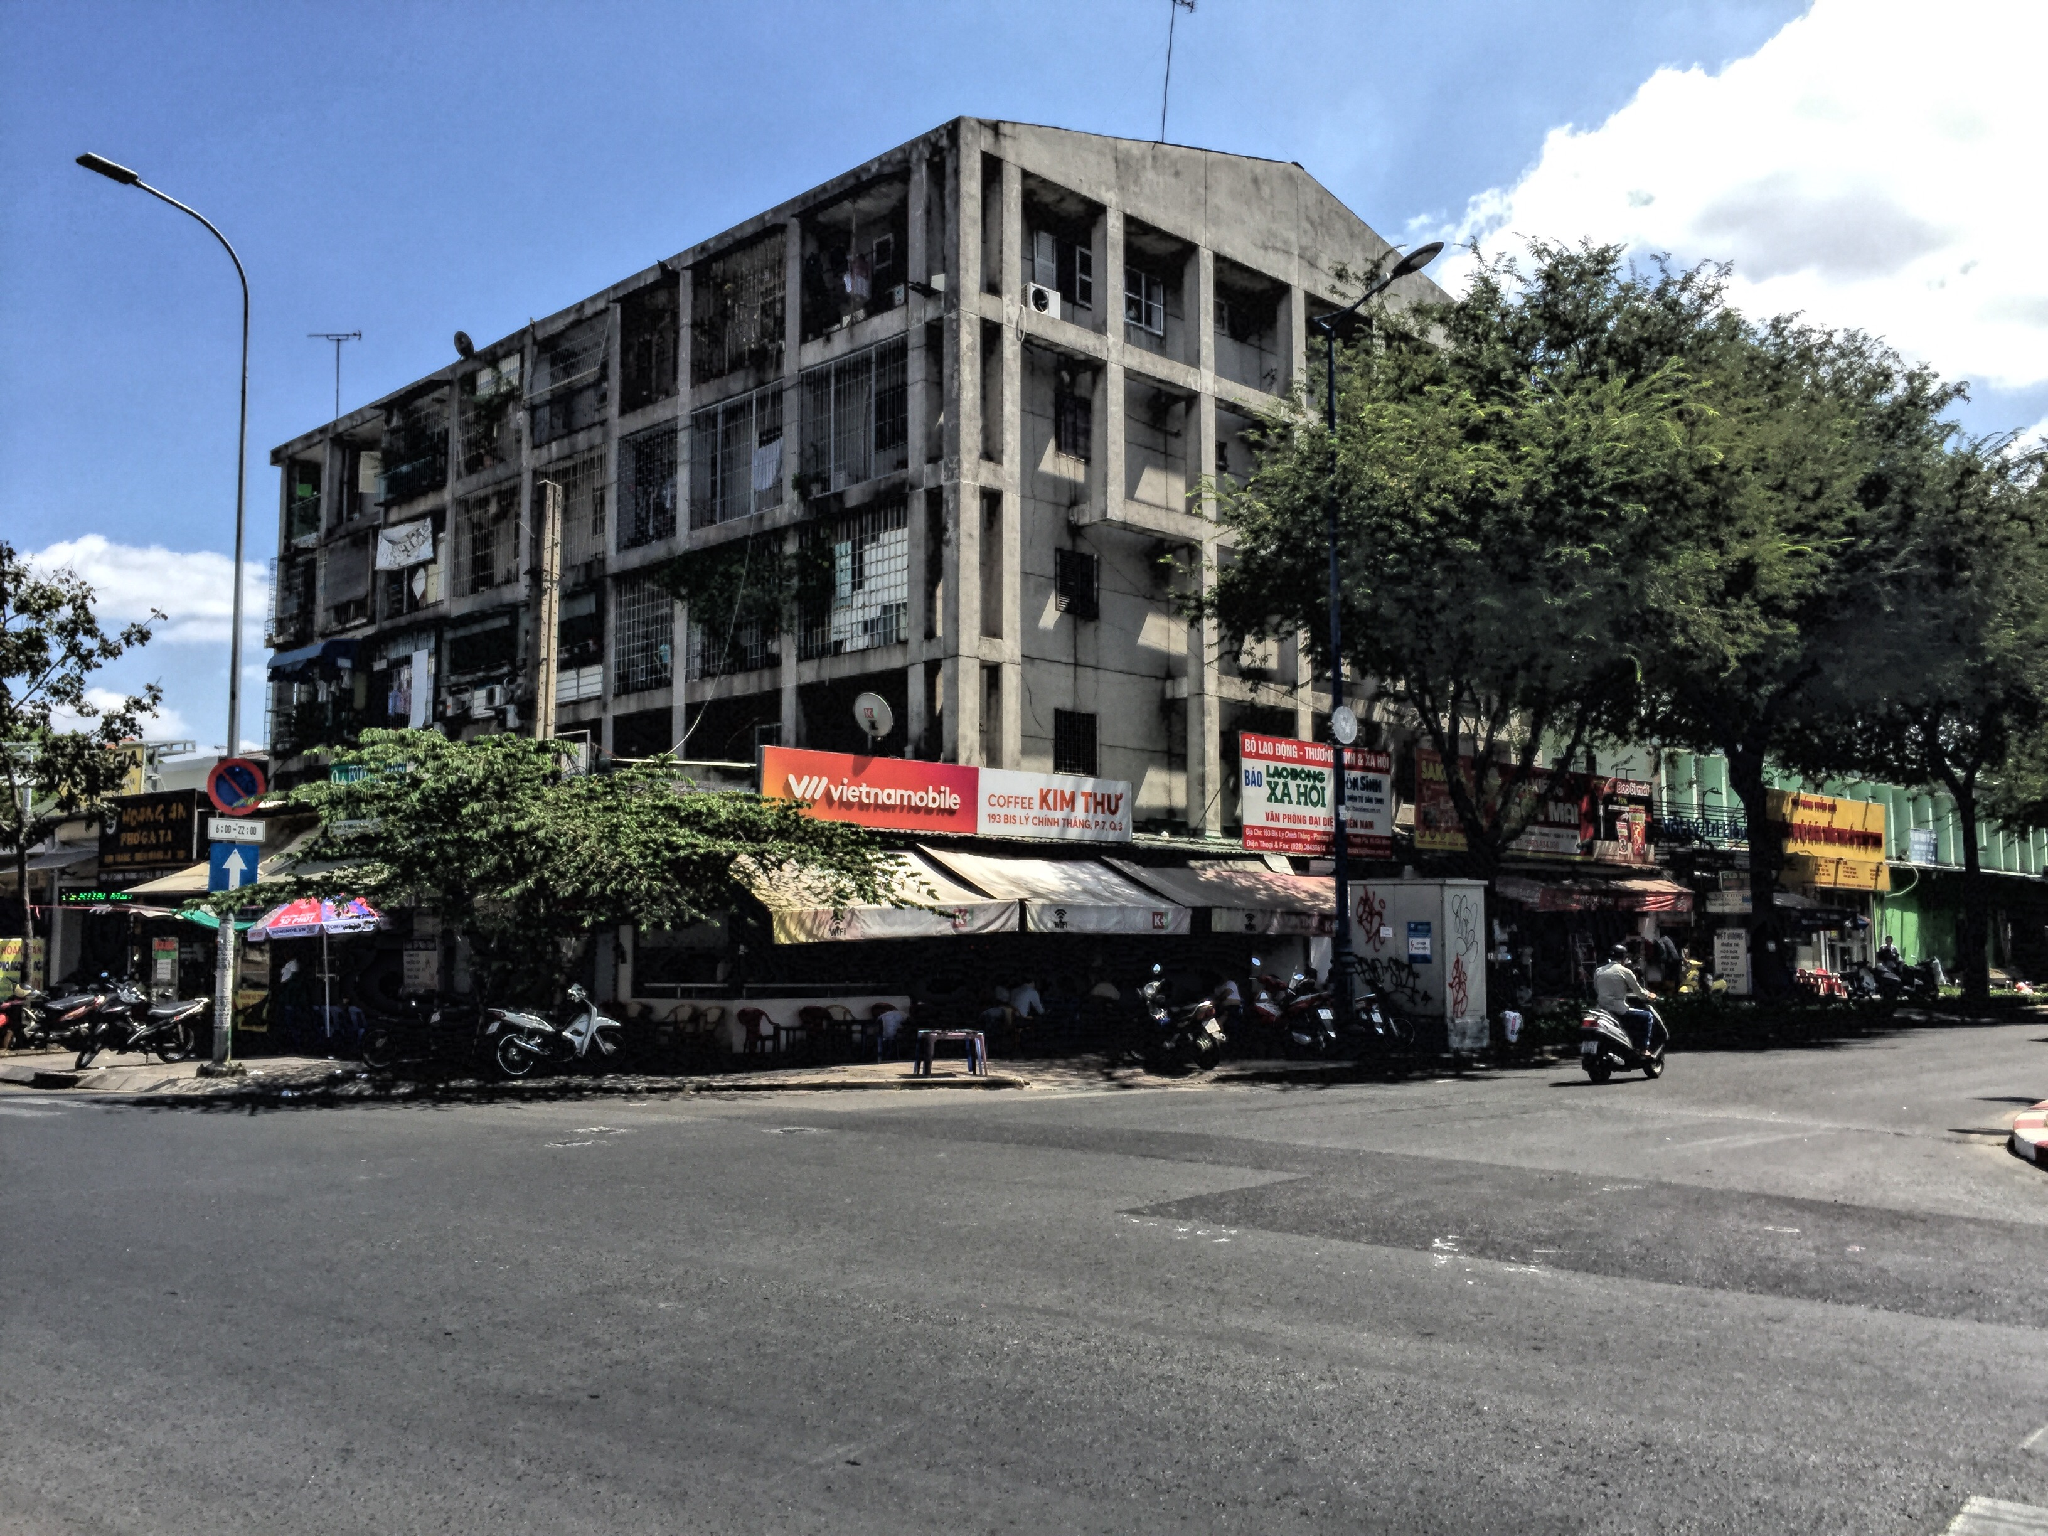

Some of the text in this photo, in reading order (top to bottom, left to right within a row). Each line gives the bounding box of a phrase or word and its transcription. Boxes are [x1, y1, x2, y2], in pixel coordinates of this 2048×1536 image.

[1244, 738, 1257, 757] BỘ
[1258, 743, 1274, 758] LAO
[1275, 743, 1298, 762] ĐỘNG
[1357, 753, 1364, 766] &
[1244, 767, 1263, 787] BÁO
[829, 777, 961, 810] vietnamobile
[987, 788, 1123, 816] COFFEE KIM THƯ
[1266, 780, 1293, 805] XÃ
[987, 813, 1002, 824] 193
[1003, 814, 1017, 825] BIS
[1020, 813, 1030, 825] LÝ
[1032, 814, 1060, 828] CHÍNH
[1265, 811, 1280, 823] VĂN
[1282, 812, 1307, 825] PHÒNG
[1308, 815, 1321, 828] ĐẠI
[1322, 816, 1334, 829] DIỆ
